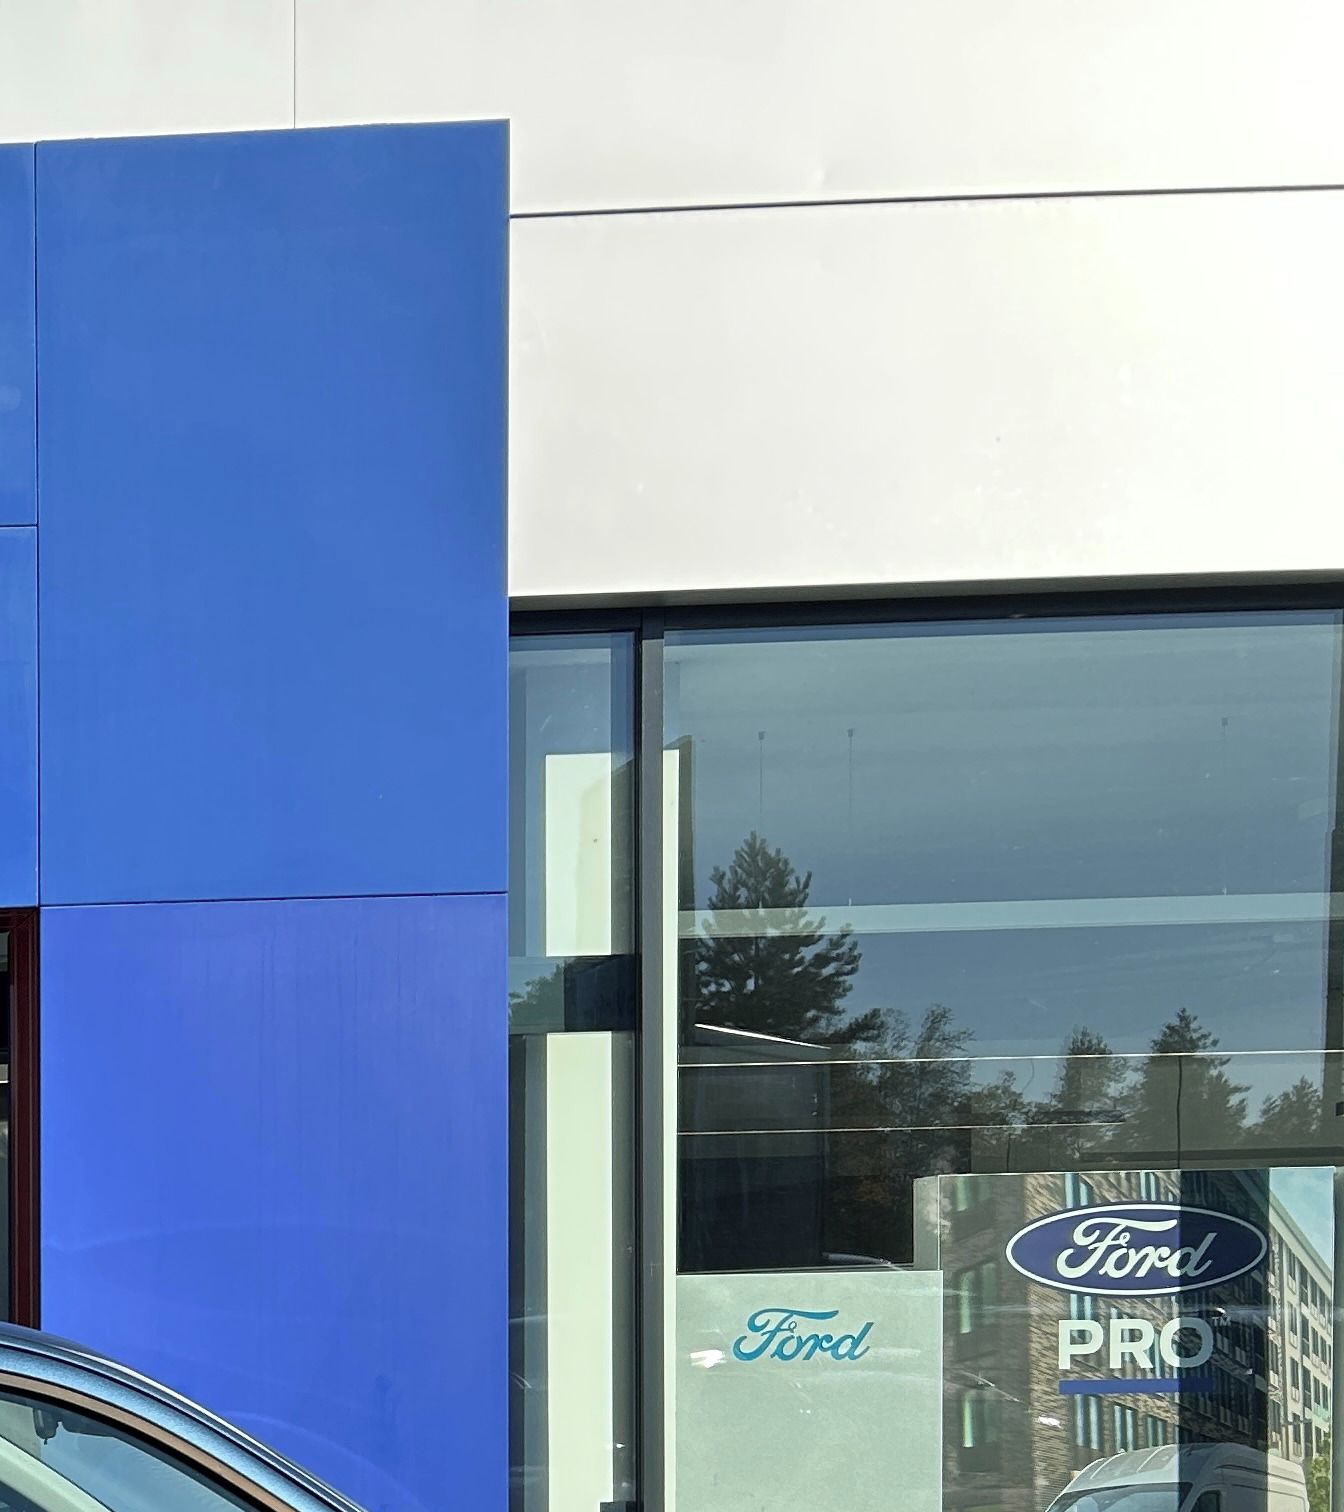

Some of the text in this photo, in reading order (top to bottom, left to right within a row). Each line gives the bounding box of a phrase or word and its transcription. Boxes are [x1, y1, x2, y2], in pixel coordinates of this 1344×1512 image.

[1056, 1216, 1218, 1280] Ford
[732, 1307, 874, 1361] Ford
[1058, 1317, 1214, 1370] PRO
